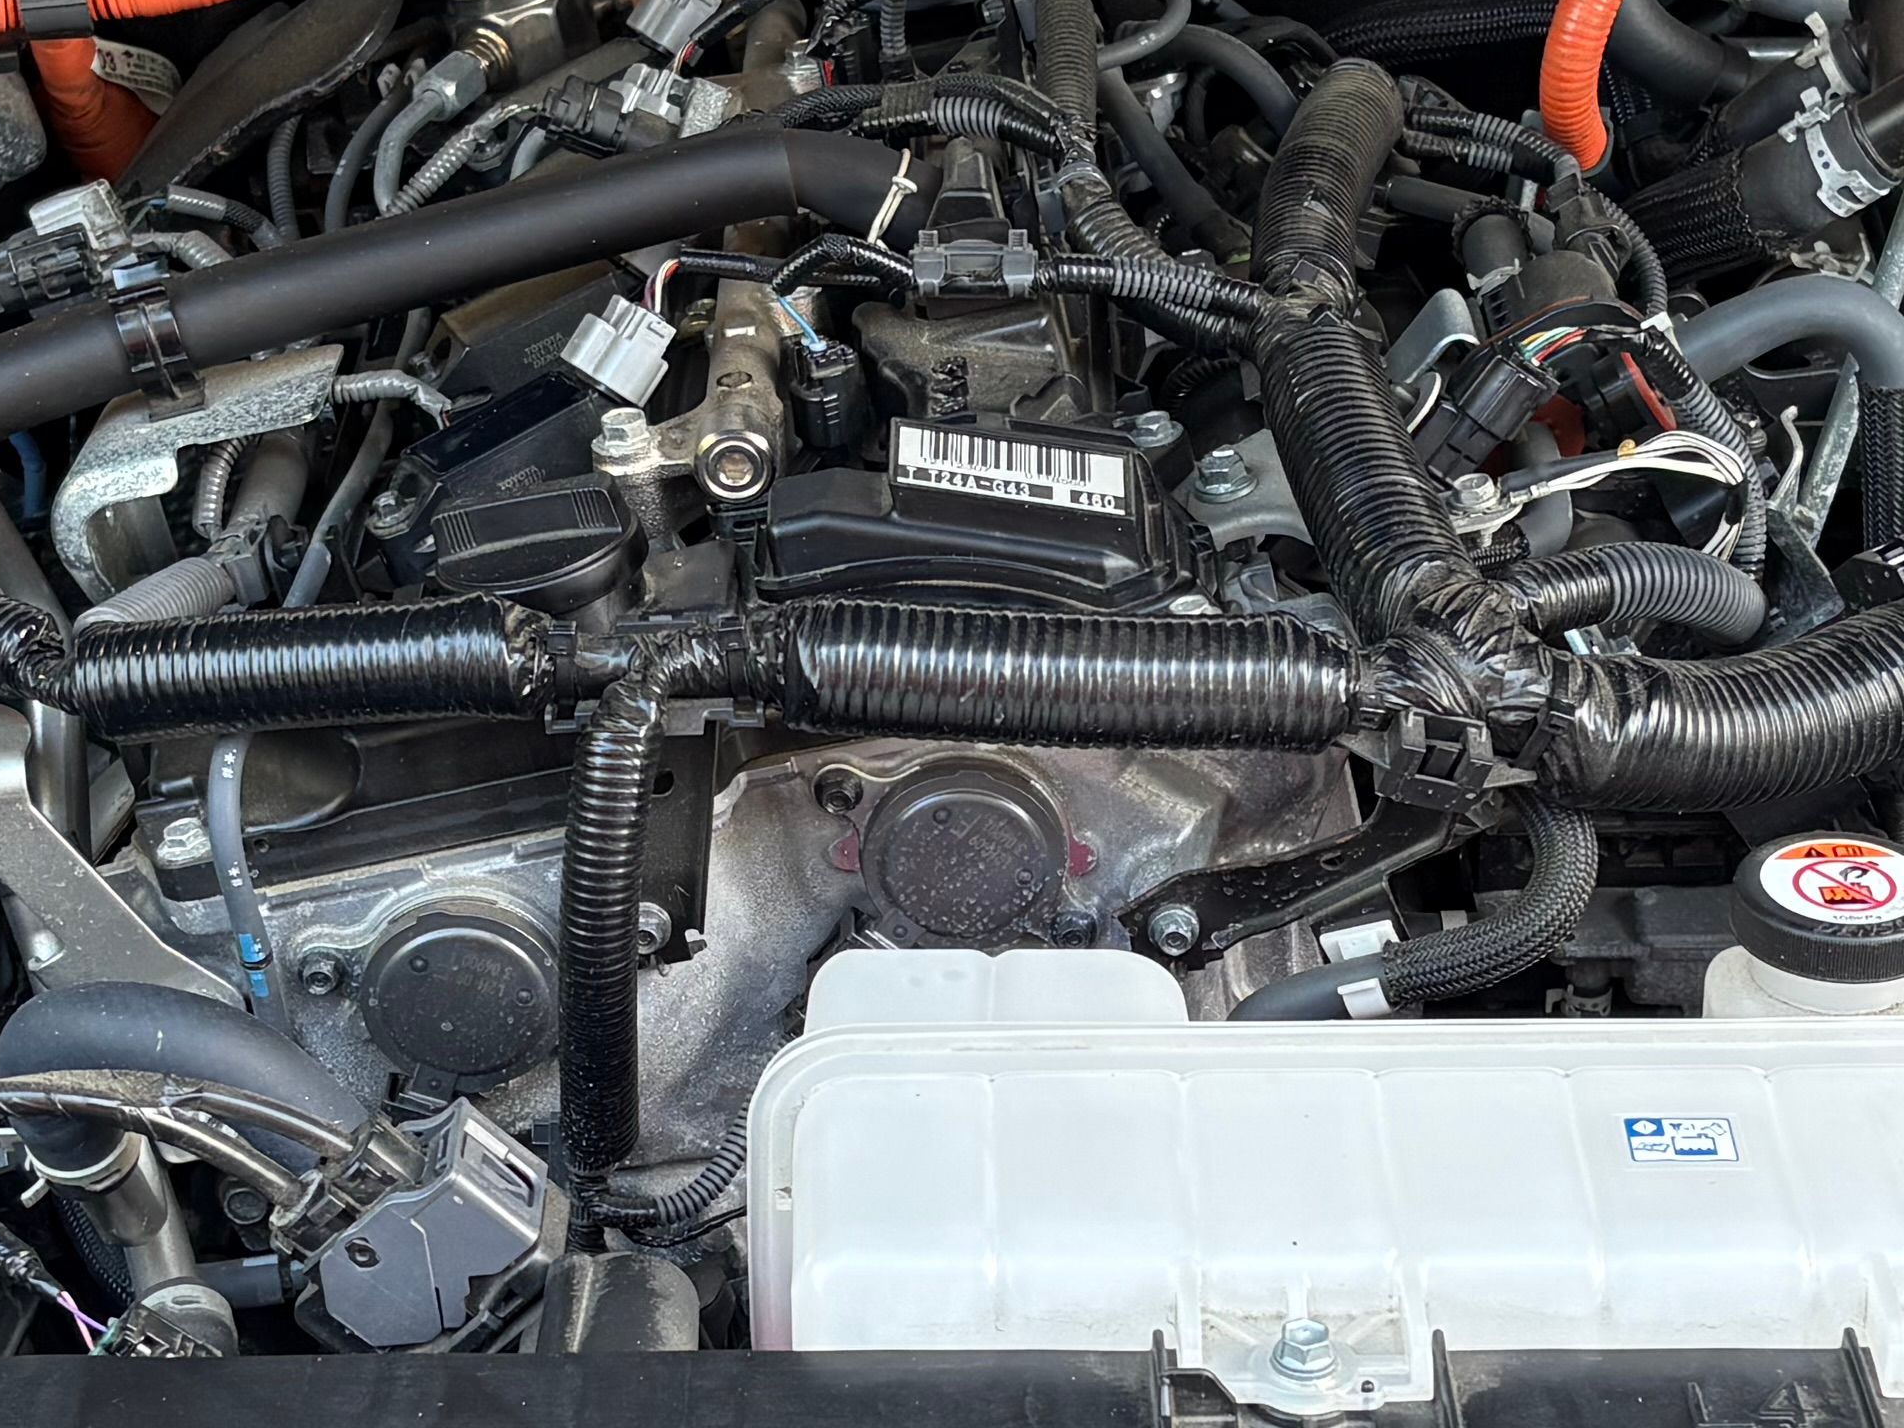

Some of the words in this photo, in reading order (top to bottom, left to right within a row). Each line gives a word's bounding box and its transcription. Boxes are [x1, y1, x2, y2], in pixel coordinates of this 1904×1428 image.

[524, 332, 566, 357] TOYOTA
[497, 464, 544, 491] TOYOTA
[927, 469, 1031, 497] T24A-G43
[1078, 490, 1116, 510] 460
